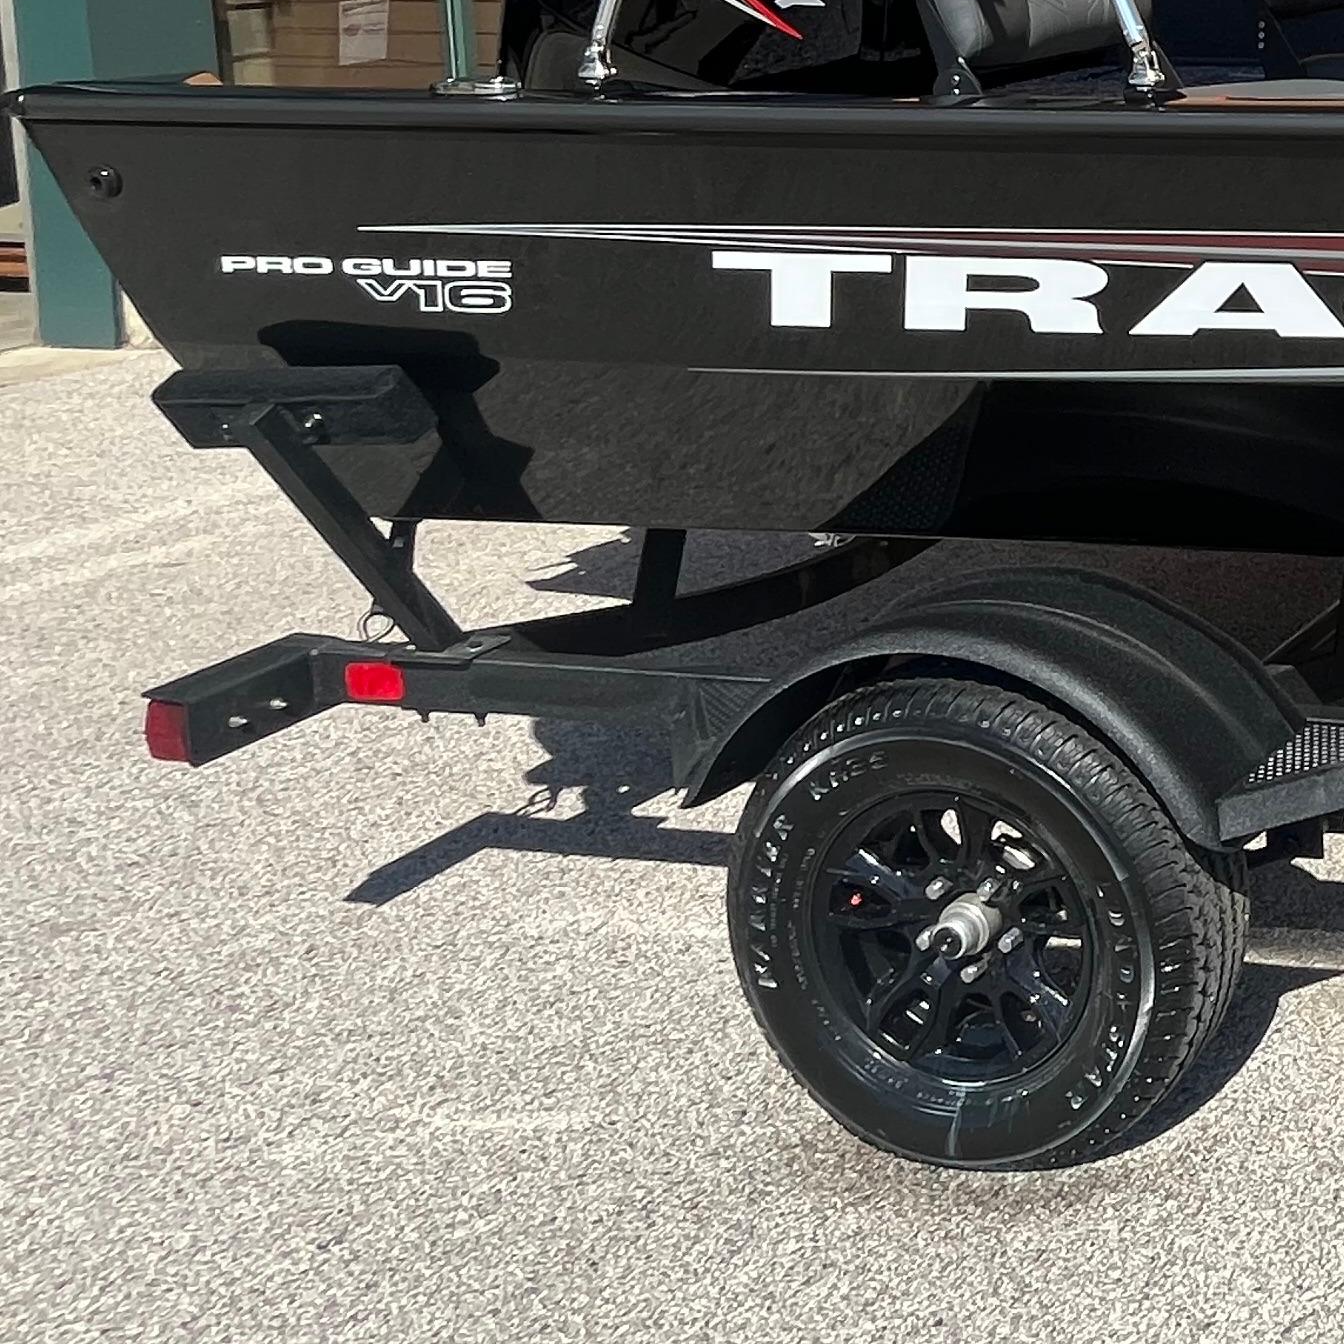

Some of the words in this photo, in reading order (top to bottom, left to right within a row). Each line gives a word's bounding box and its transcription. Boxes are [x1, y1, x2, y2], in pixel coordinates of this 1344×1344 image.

[220, 255, 333, 275] PRO
[341, 256, 513, 278] GUIDE
[356, 278, 513, 314] V16
